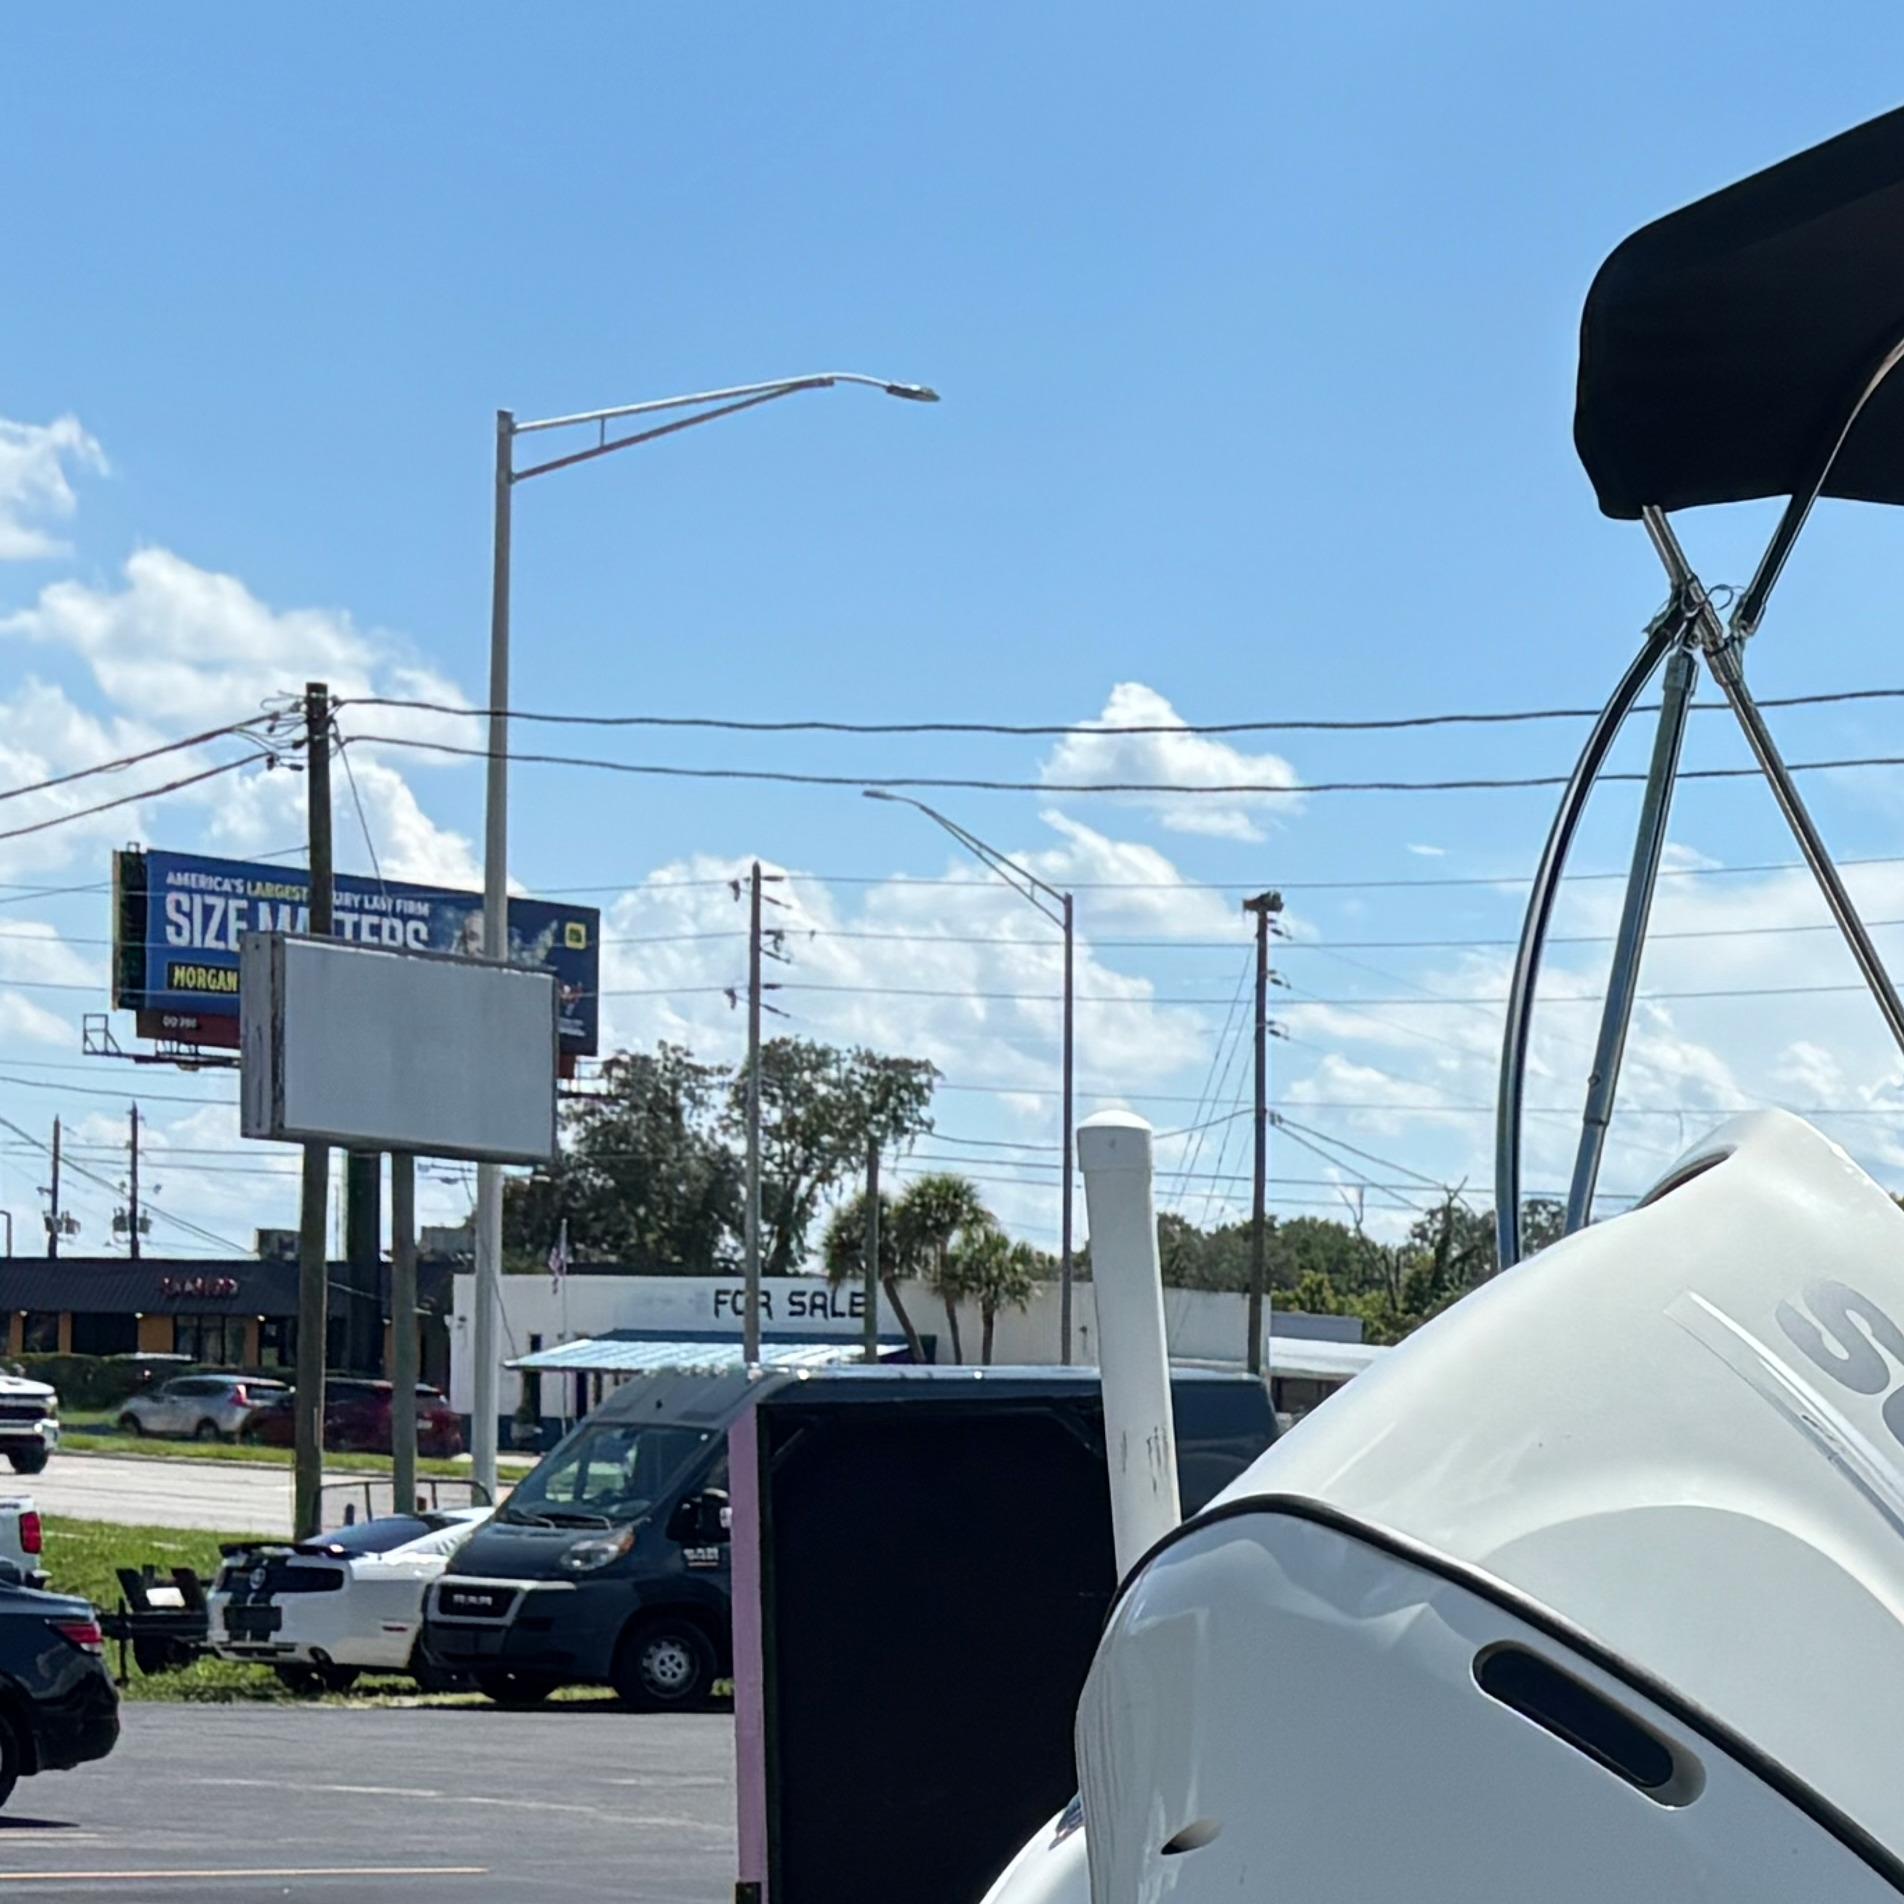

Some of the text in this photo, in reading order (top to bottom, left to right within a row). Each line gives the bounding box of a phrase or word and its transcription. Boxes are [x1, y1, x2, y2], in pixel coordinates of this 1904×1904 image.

[165, 871, 244, 895] AMERICA'S
[246, 881, 309, 902] LARGEST
[396, 899, 430, 918] FIRM
[165, 891, 249, 952] SIZE
[173, 965, 238, 992] MORGAN
[714, 1289, 867, 1321] FOR SALE
